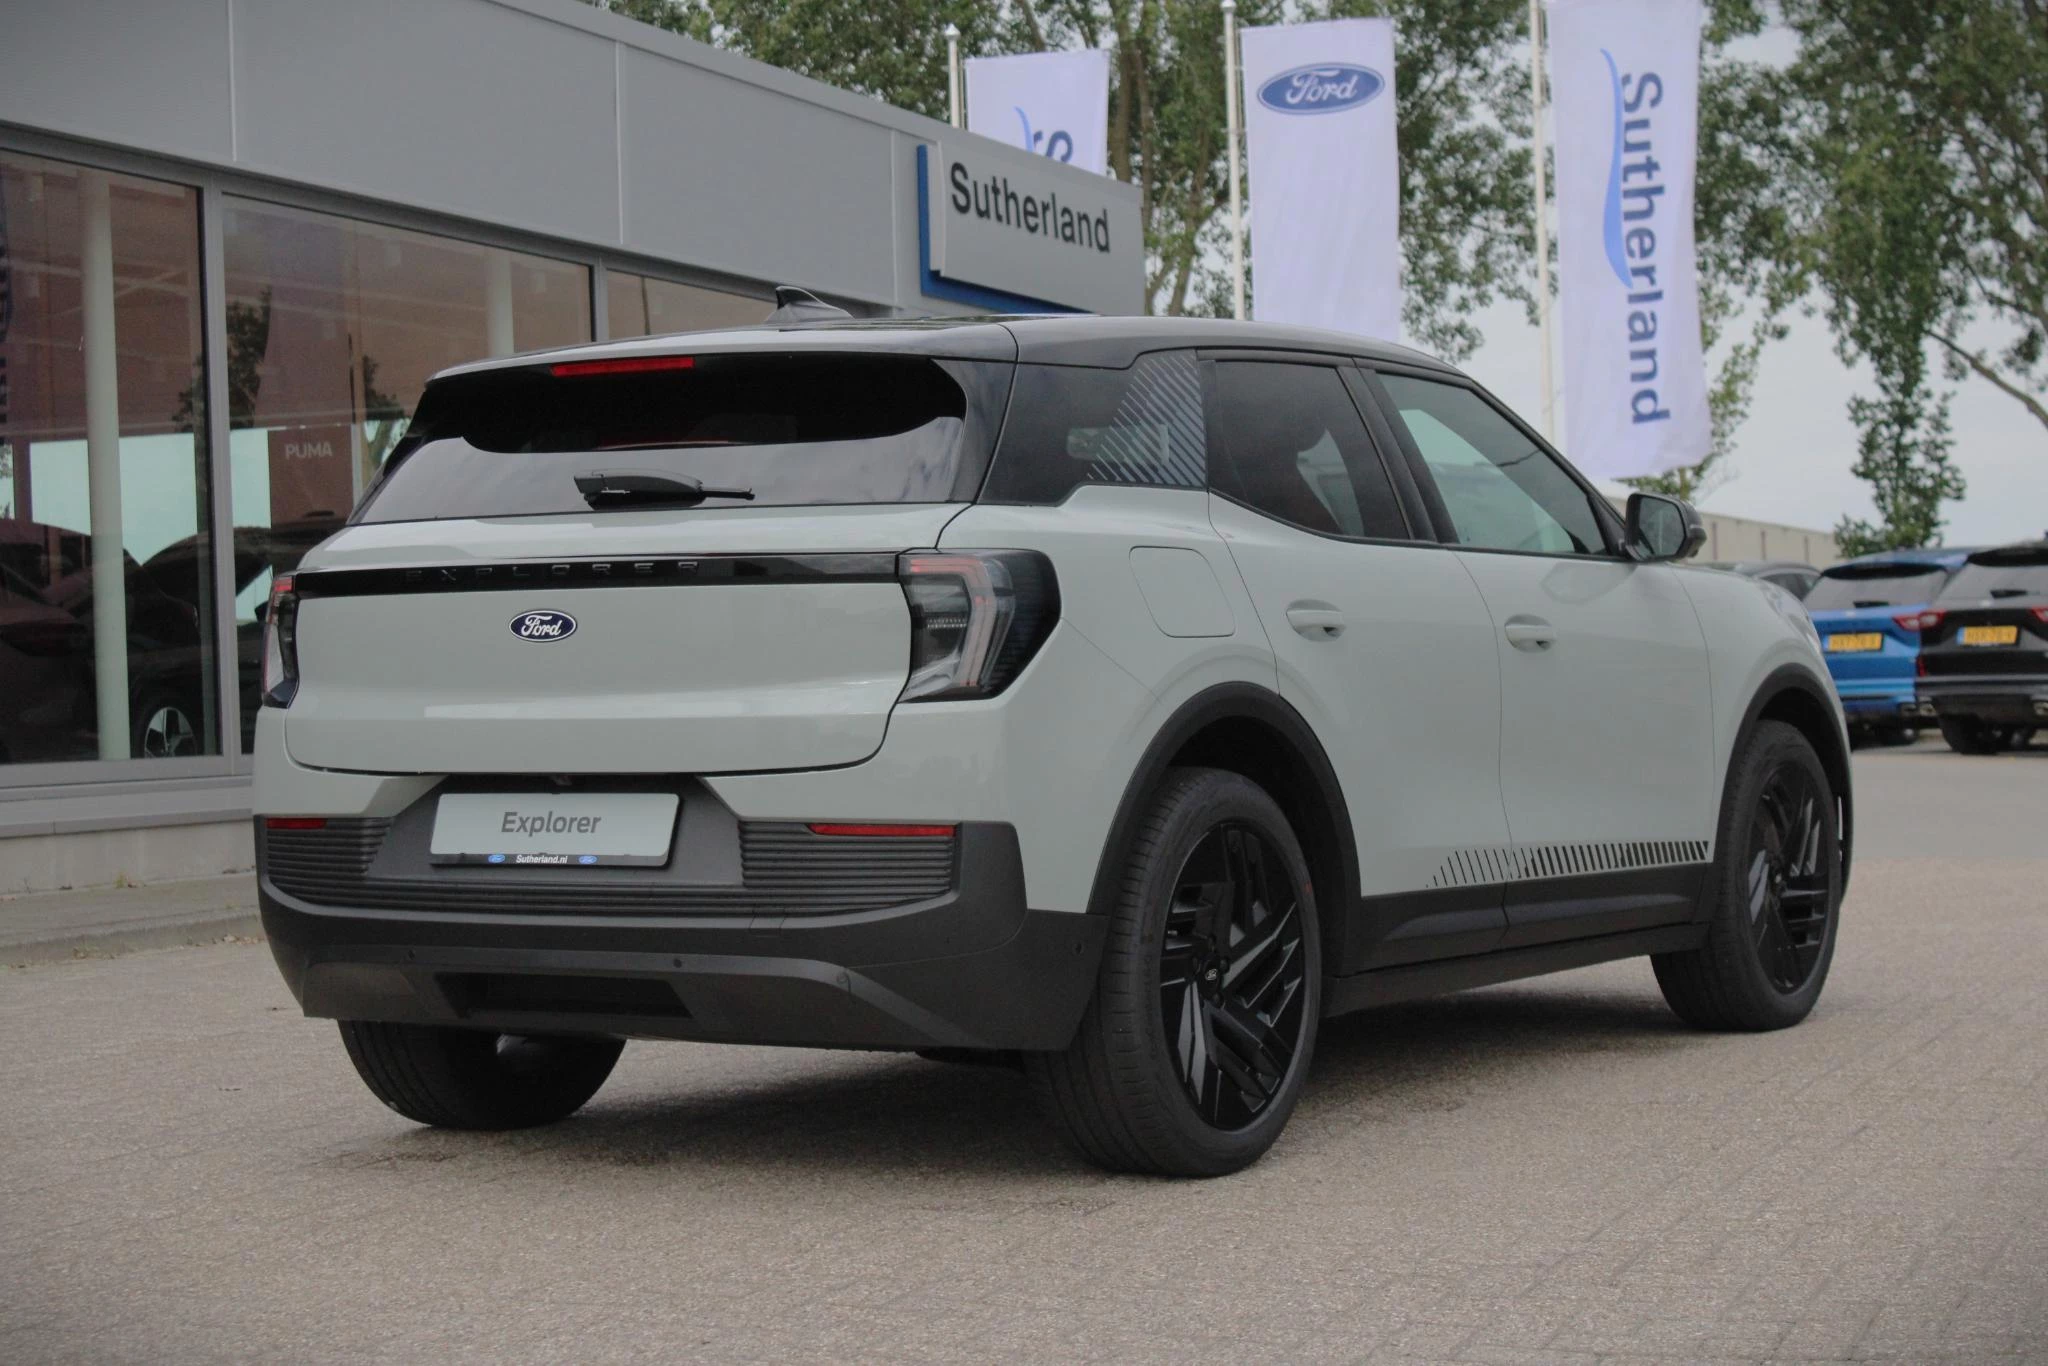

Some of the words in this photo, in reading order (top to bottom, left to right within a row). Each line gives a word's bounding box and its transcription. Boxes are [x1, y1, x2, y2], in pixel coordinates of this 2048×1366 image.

[1286, 69, 1359, 104] Ford
[951, 162, 1110, 253] Sutherland
[1621, 71, 1671, 424] Sutherland
[284, 441, 333, 460] PUMA
[521, 614, 563, 636] Ford
[501, 811, 602, 837] Explorer
[515, 854, 568, 864] Sutherland.nl
